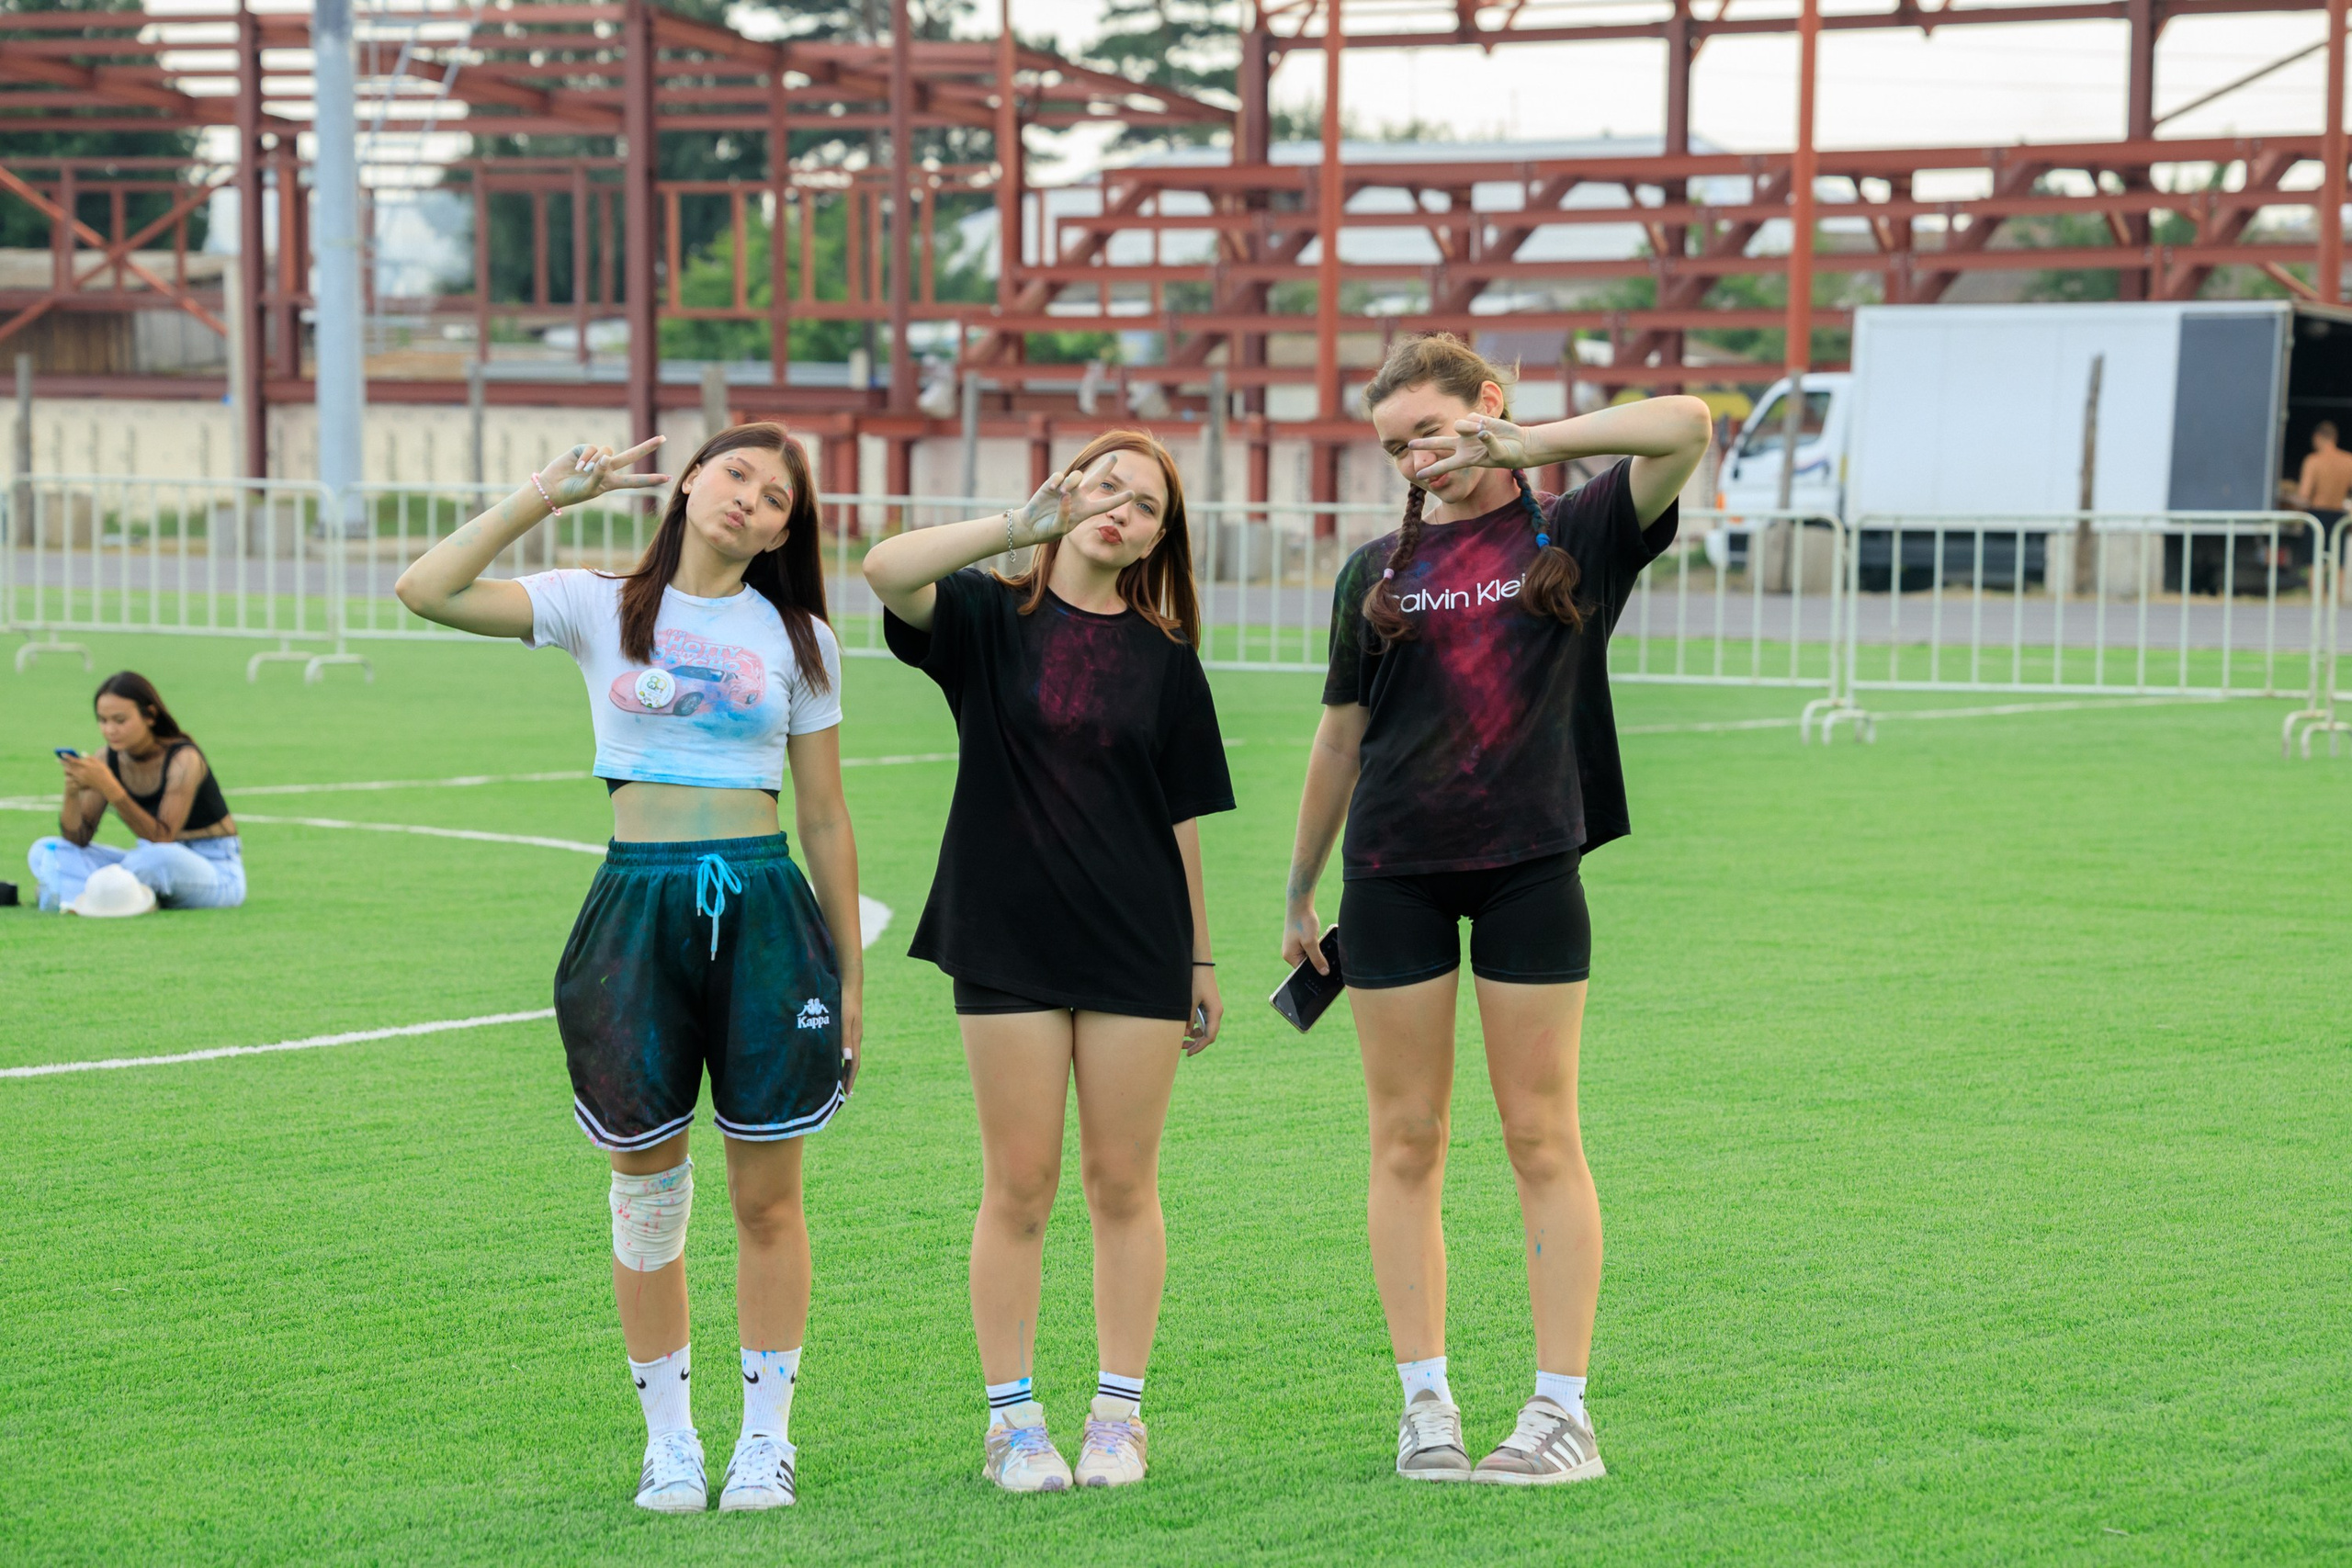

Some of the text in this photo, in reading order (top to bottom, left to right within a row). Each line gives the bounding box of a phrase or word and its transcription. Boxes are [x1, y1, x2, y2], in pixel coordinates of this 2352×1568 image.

[1391, 573, 1526, 613] alvin Klei
[666, 635, 742, 658] HOTTY
[797, 1016, 830, 1029] Kappa
